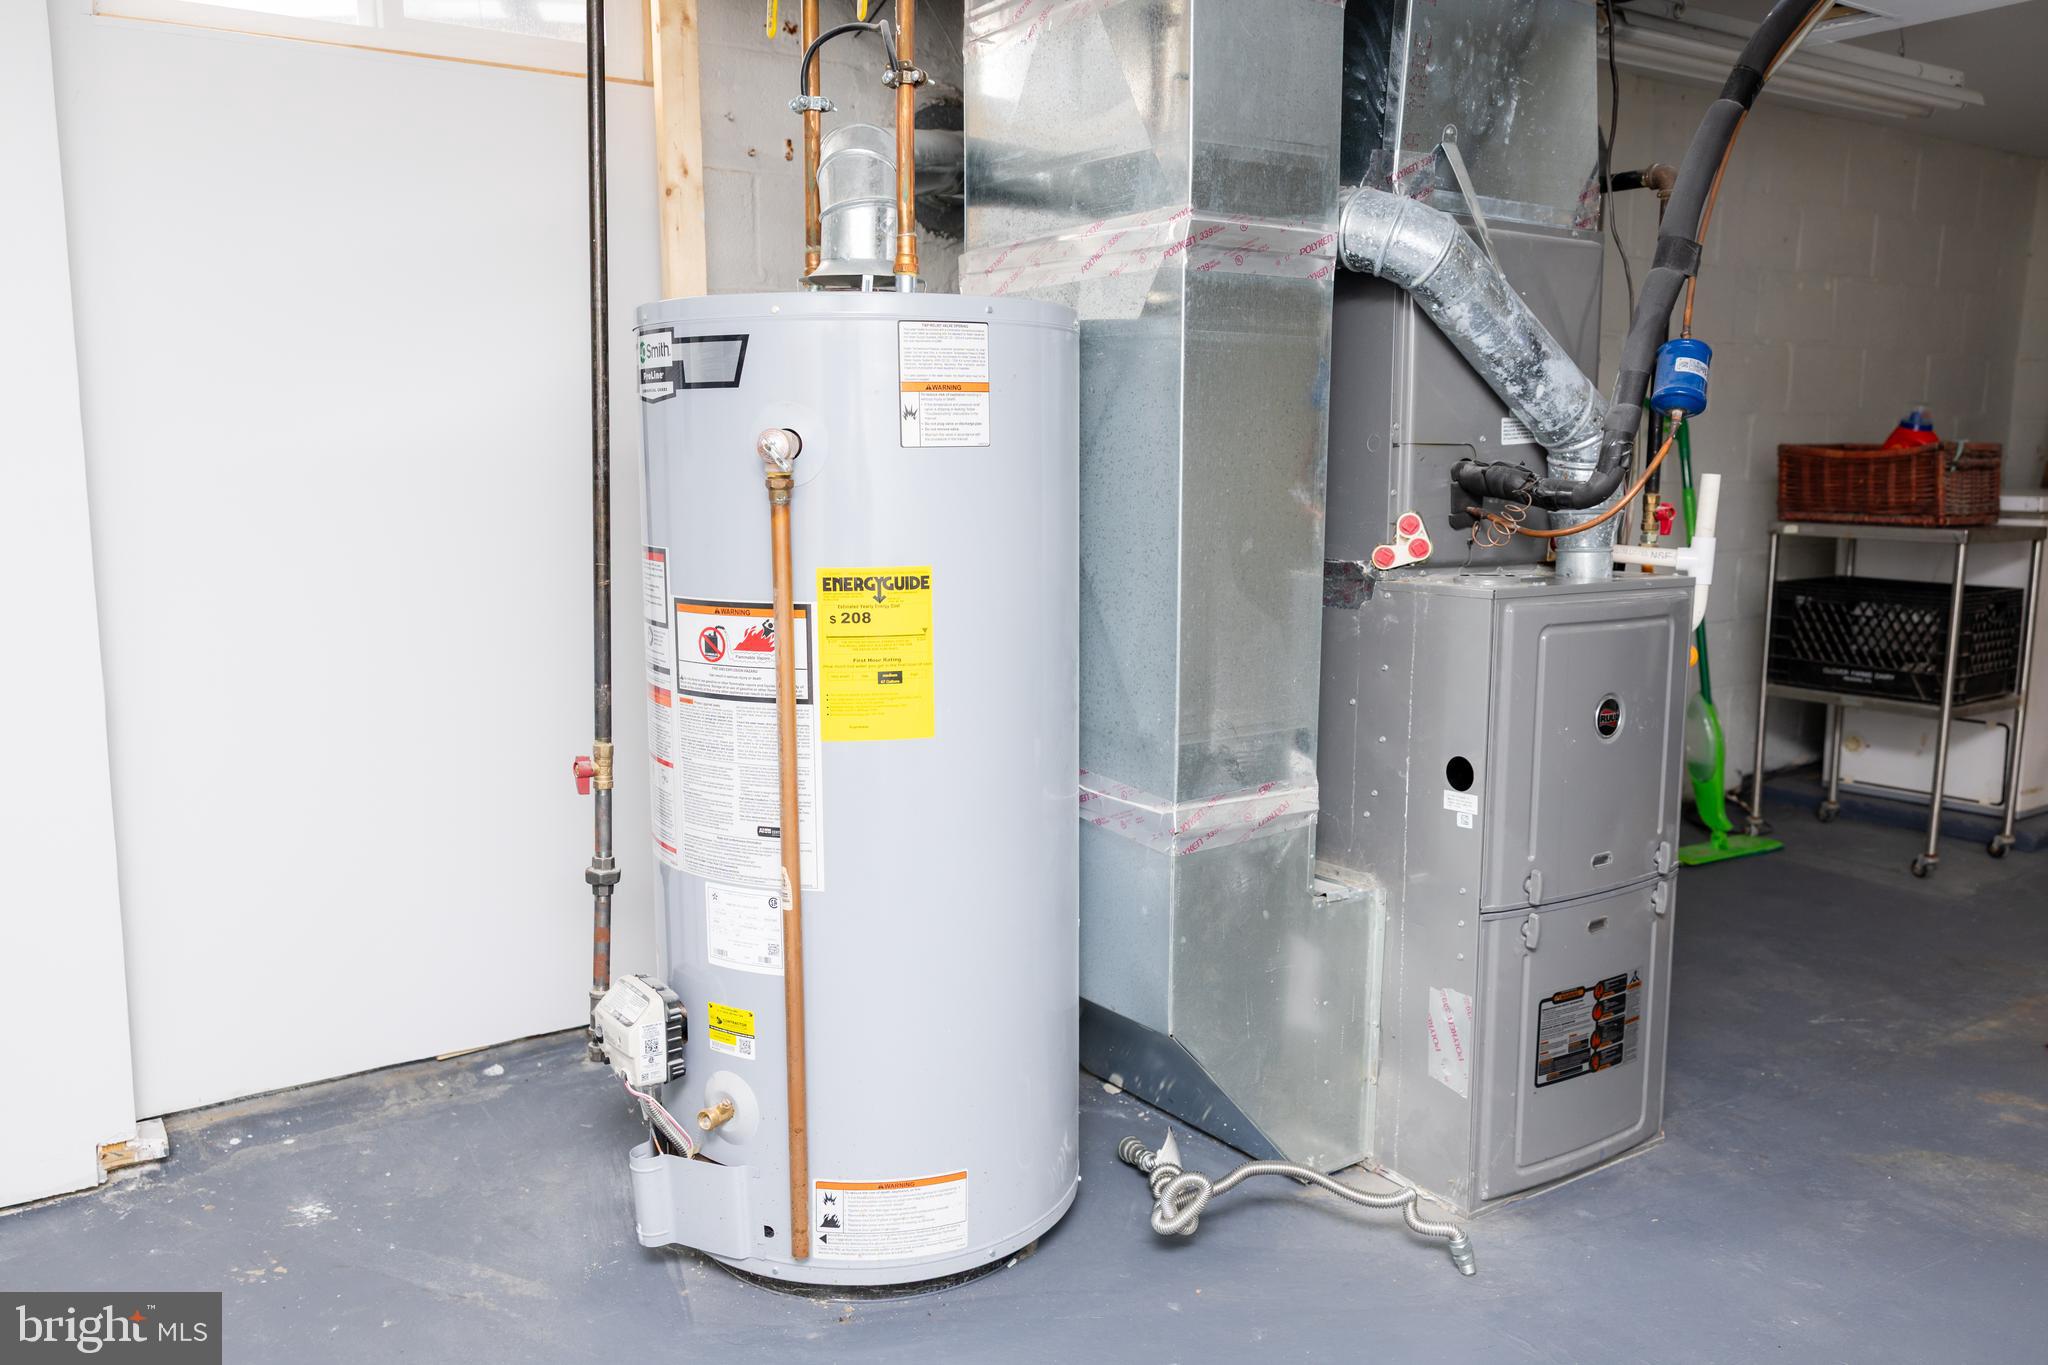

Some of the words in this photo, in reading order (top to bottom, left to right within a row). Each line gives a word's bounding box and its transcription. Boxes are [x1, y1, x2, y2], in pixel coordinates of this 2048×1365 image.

[1163, 234, 1197, 260] POLYKEN
[1199, 226, 1214, 241] 339
[1300, 234, 1334, 256] POLYKEN
[646, 342, 670, 360] Smith
[721, 608, 751, 616] WARNING
[840, 612, 872, 624] 208
[884, 1181, 916, 1190] WARNING
